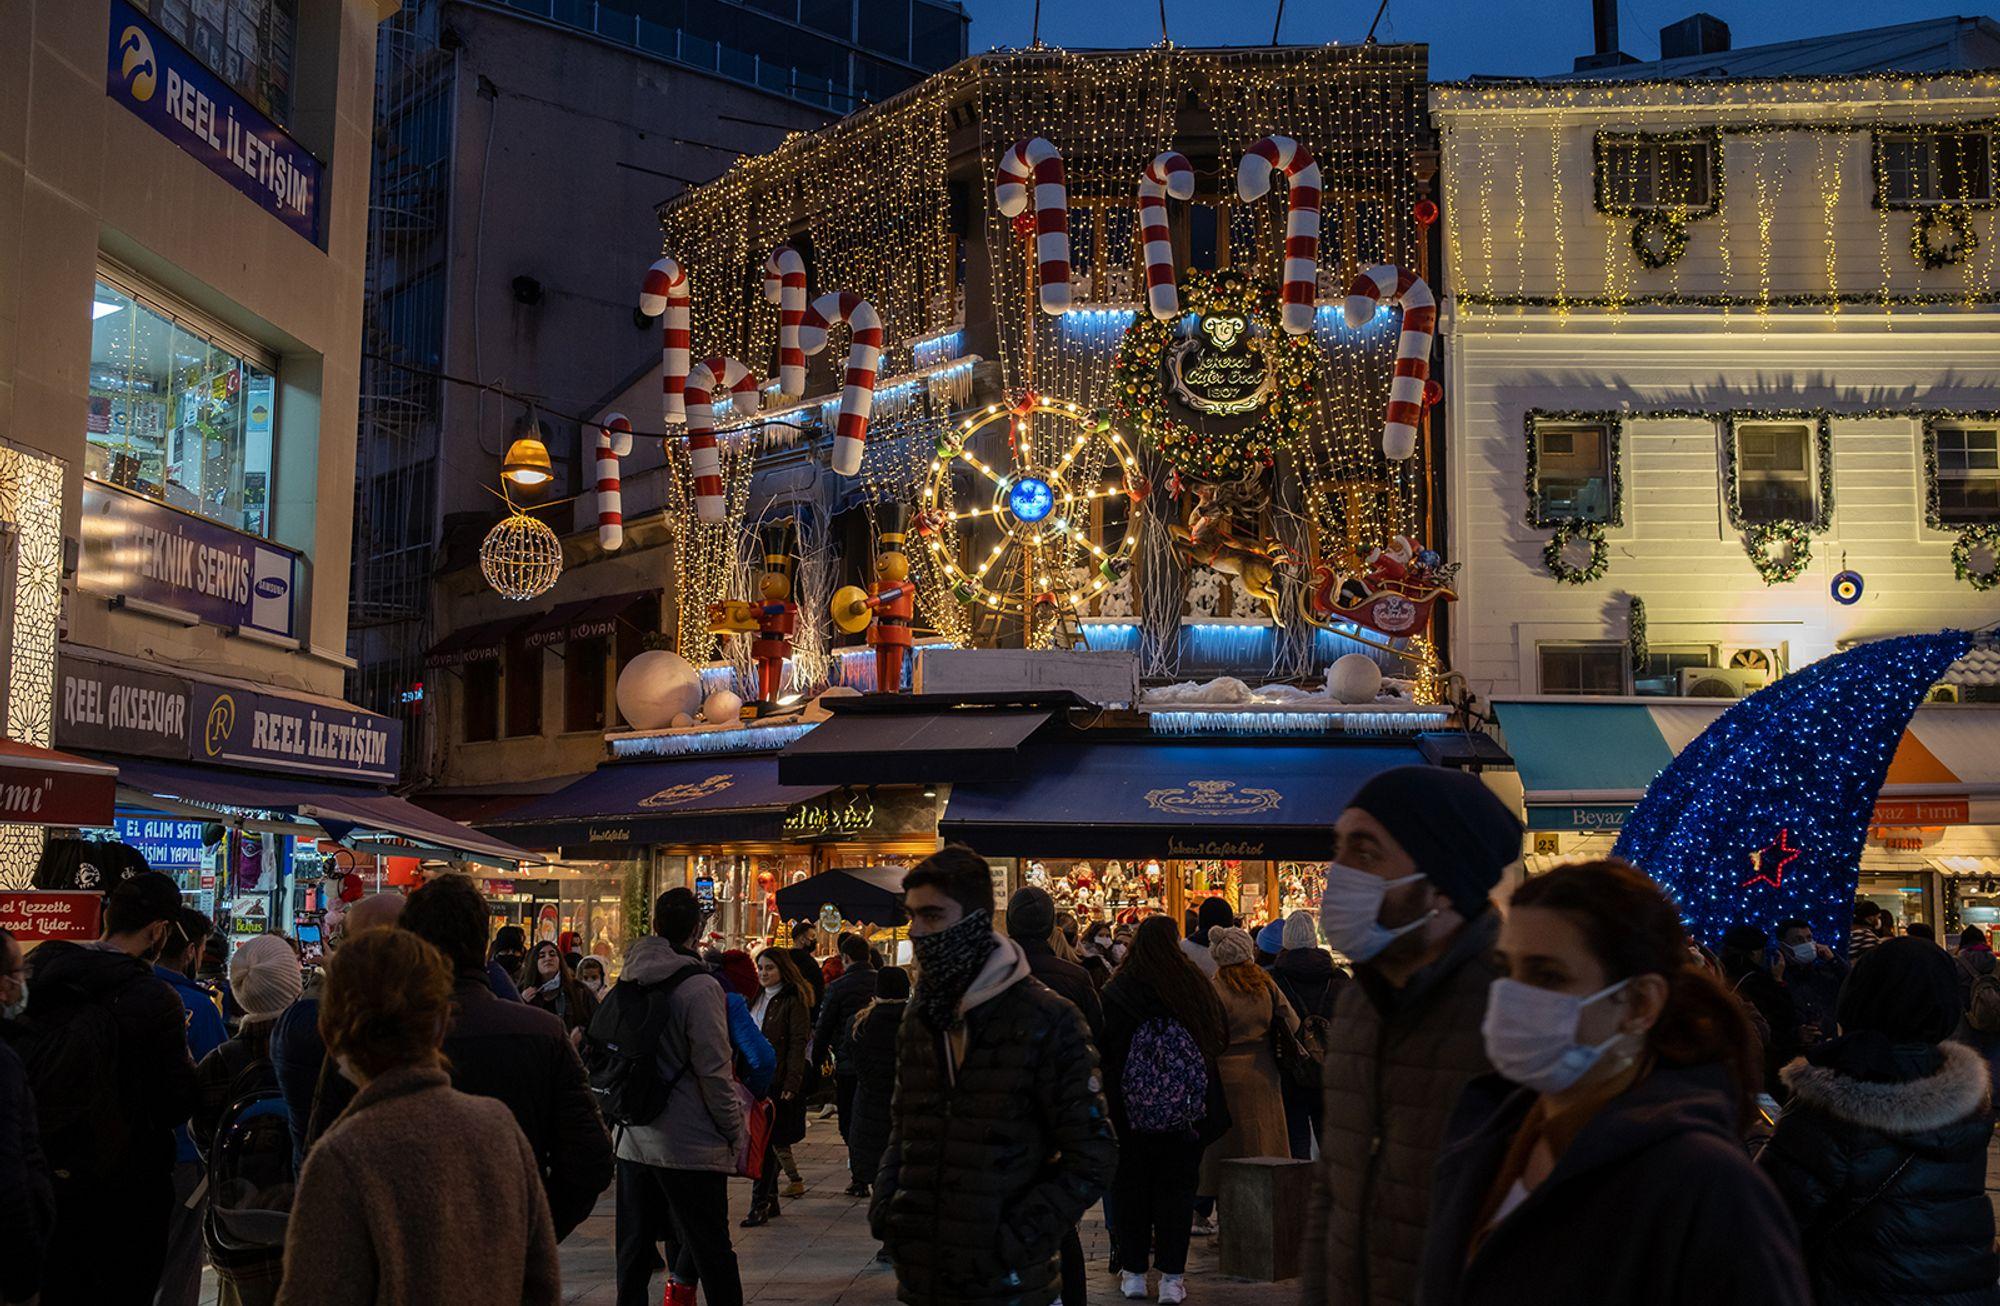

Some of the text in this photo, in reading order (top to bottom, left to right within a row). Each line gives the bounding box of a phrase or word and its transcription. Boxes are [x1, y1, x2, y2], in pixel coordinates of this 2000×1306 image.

[165, 67, 308, 216] REEL İLETİŞİM
[134, 524, 249, 605] TEKNİK SERVİS
[255, 579, 285, 597] SAMSUNG
[525, 621, 617, 649] KOVAN KOVAN
[462, 646, 499, 663] KOVAN
[64, 676, 186, 741] REEL AKSESUAR
[252, 709, 388, 769] REEL İLETİŞİM
[1573, 808, 1624, 830] Beyaz
[1916, 803, 1959, 819] Fırın
[126, 819, 140, 837] EL
[144, 821, 173, 840] ALIM
[177, 823, 202, 841] SATI
[1538, 840, 1555, 850] 23
[0, 900, 72, 918] el Lezzette
[36, 917, 86, 935] Lider...
